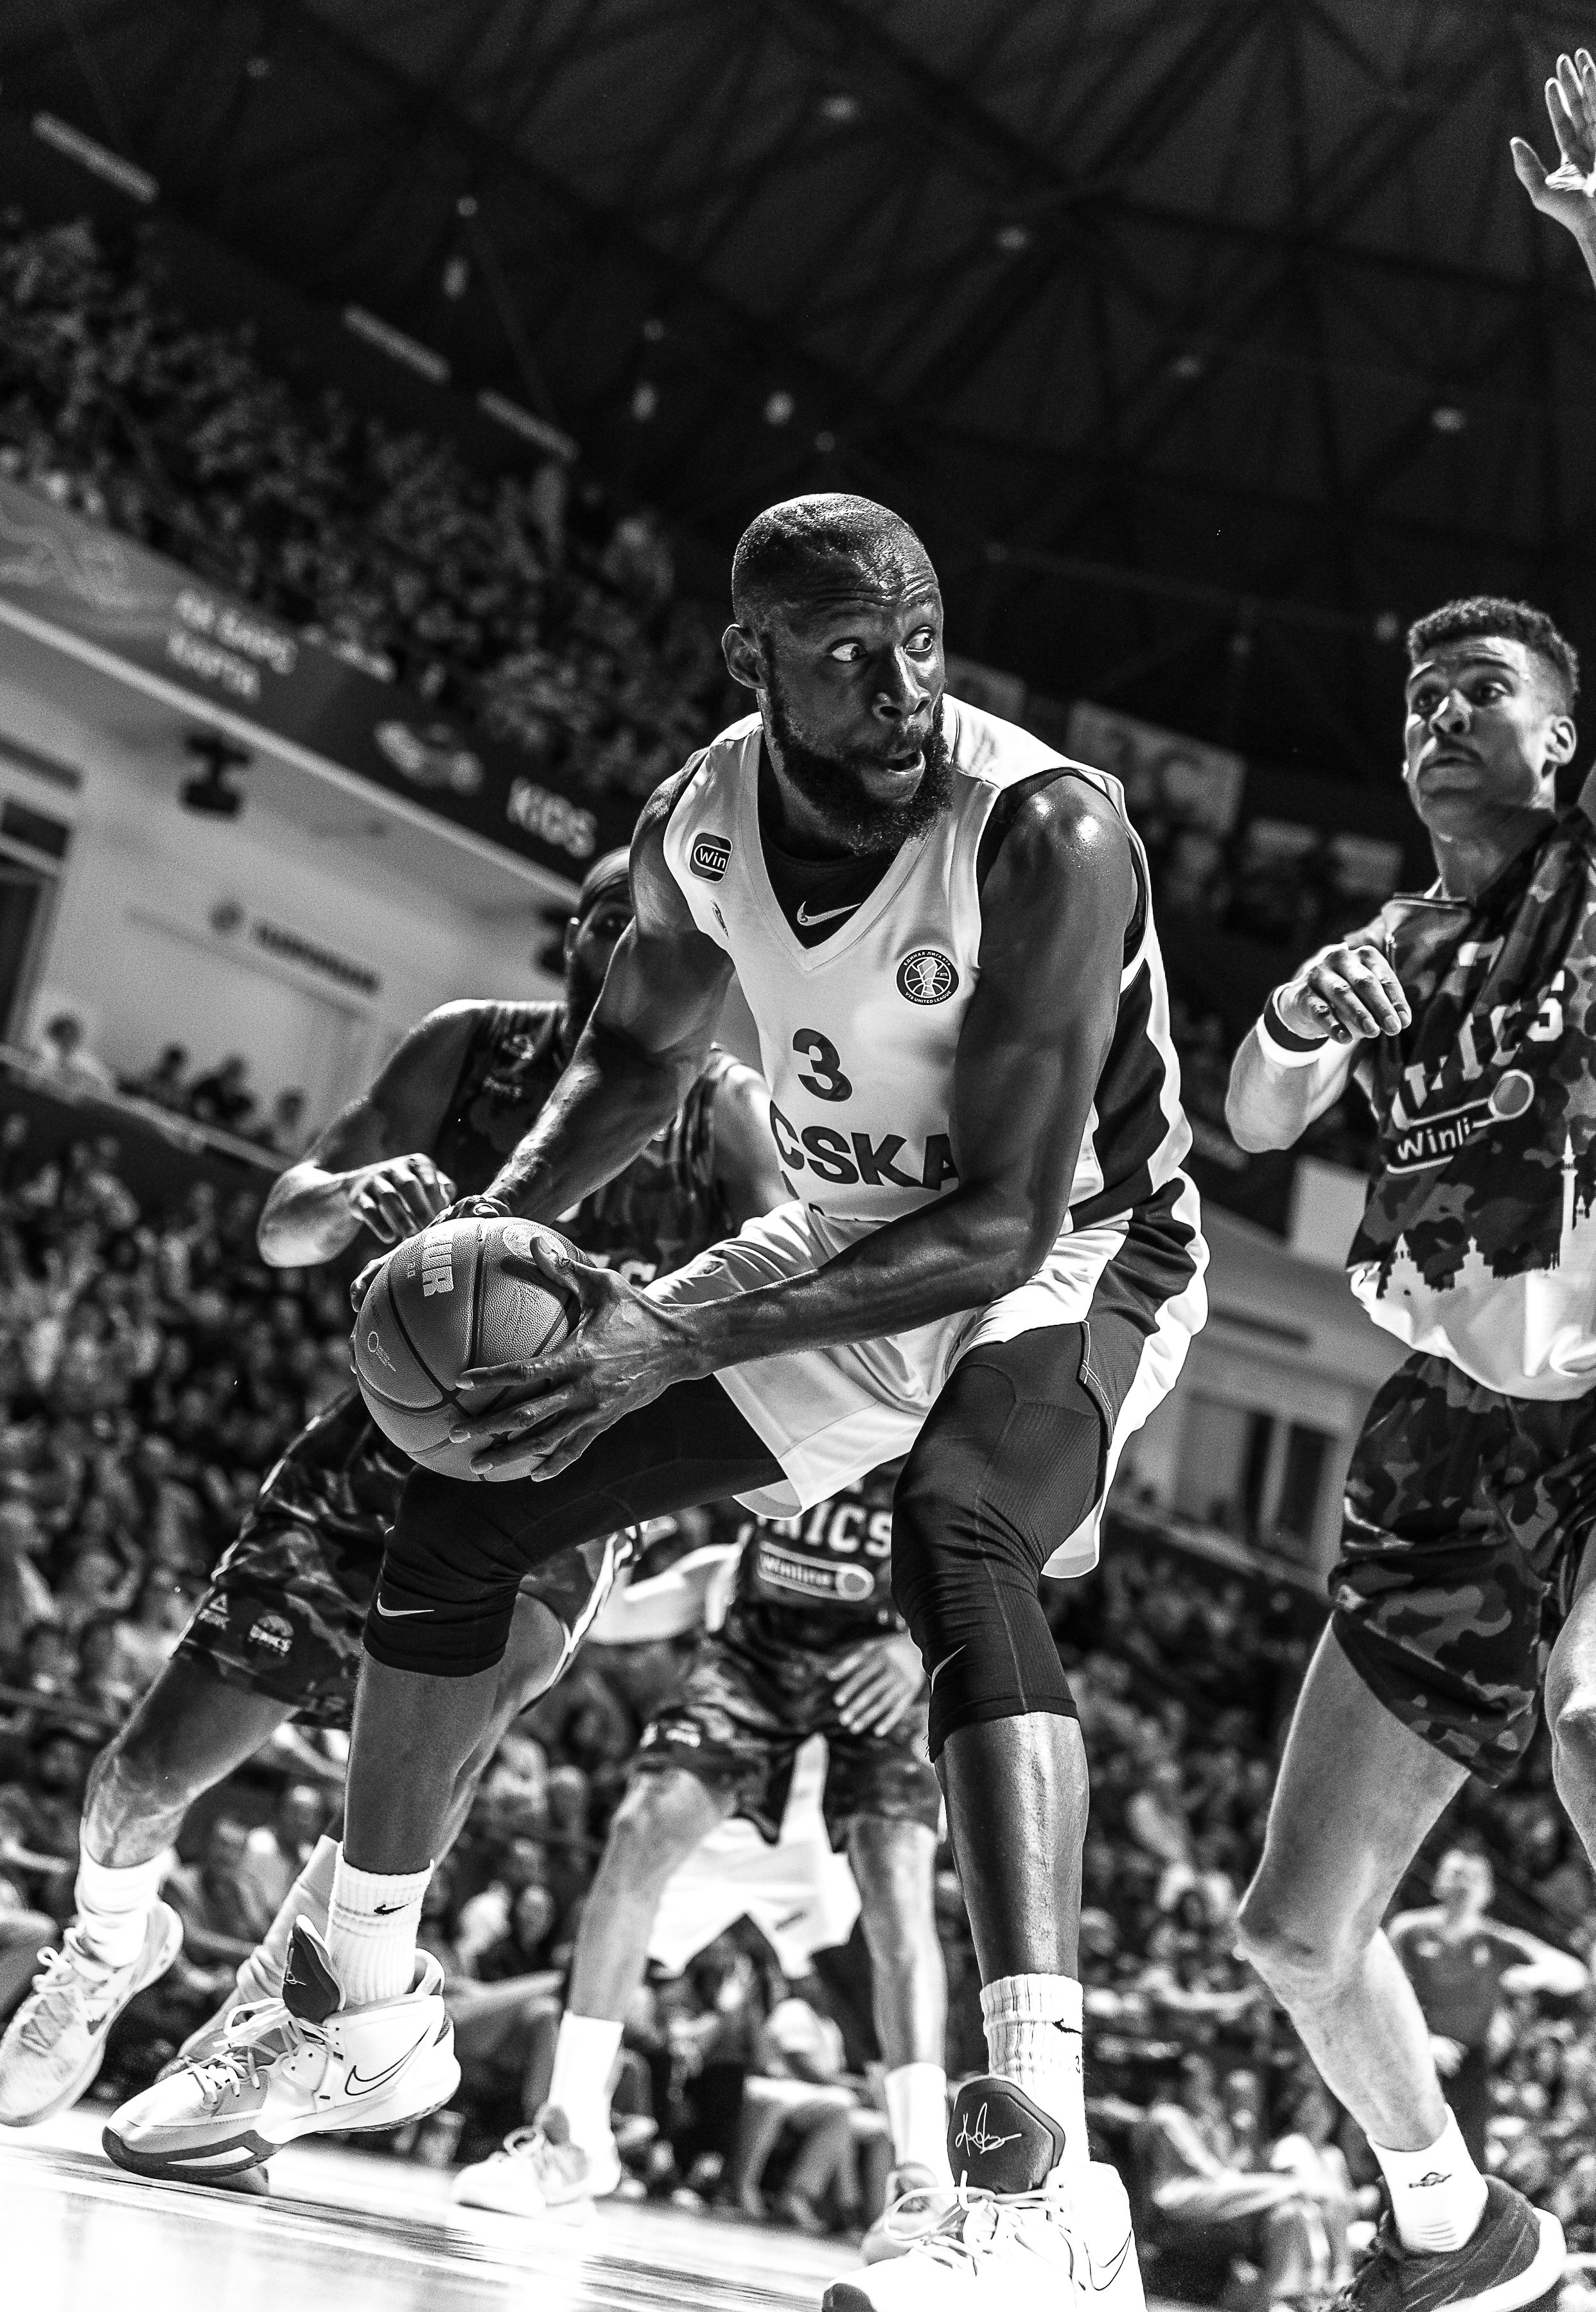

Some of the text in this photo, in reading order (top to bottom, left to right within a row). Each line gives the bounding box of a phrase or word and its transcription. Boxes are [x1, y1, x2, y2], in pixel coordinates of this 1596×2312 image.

[699, 848, 726, 869] Win
[903, 951, 925, 966] ЕДИНАЯ
[905, 992, 914, 1000] VTB
[934, 990, 952, 1003] LEAGUE
[793, 1028, 853, 1103] 3
[769, 1099, 960, 1192] CSKA
